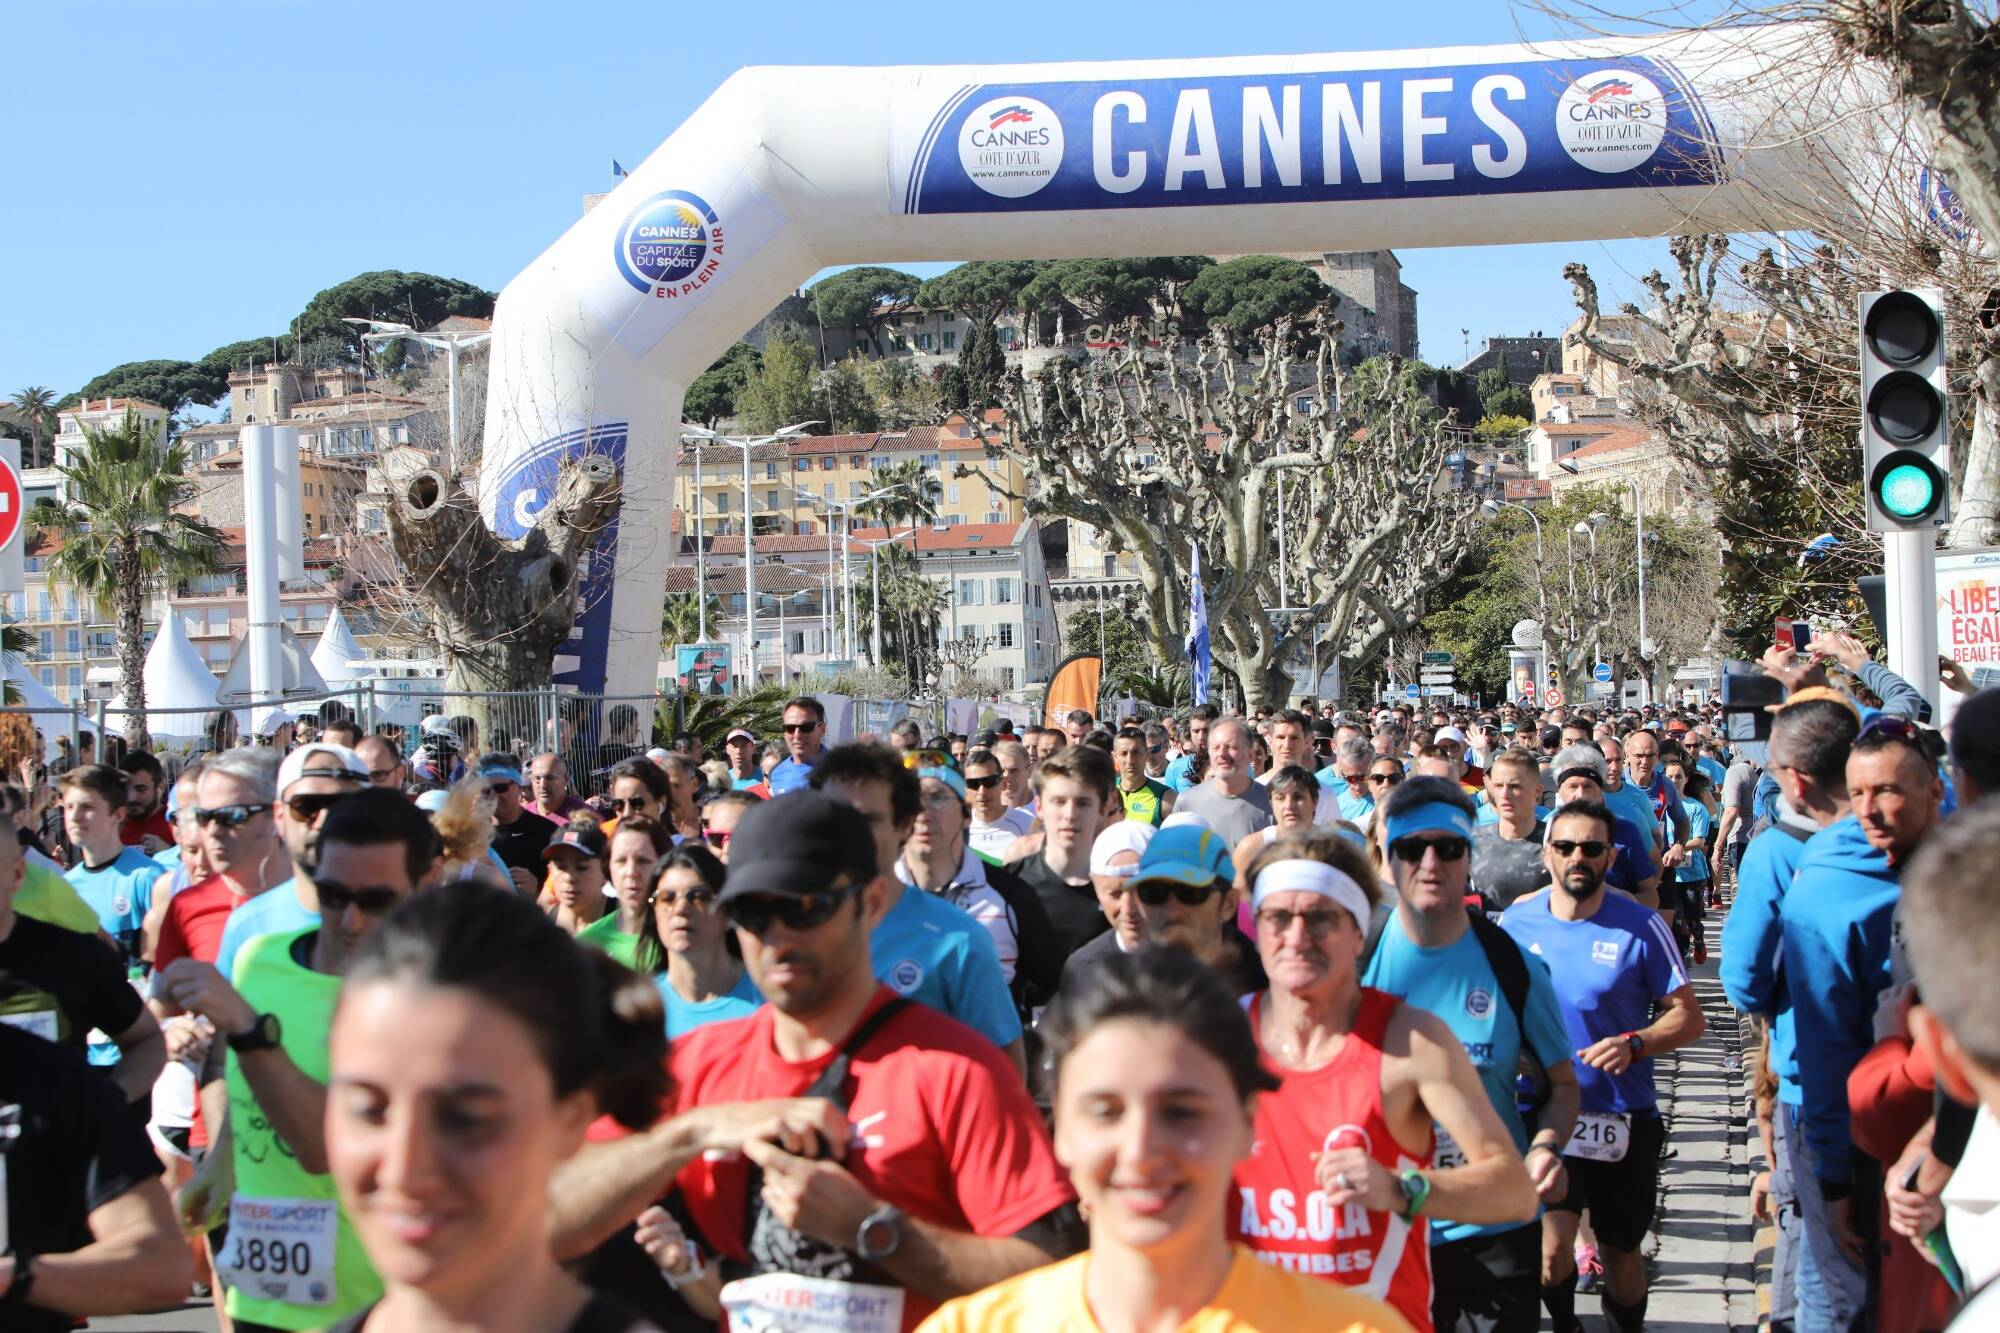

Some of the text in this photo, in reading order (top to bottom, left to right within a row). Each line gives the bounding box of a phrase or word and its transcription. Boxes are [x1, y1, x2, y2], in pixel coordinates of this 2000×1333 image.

[1569, 103, 1651, 122] CANNES
[972, 128, 1049, 147] CANNES
[1093, 75, 1527, 193] CANNES
[1578, 123, 1641, 140] CÔTE D'AZUR
[1570, 142, 1652, 154] www.cannes.com
[980, 149, 1040, 166] CÔTE D'AZUR
[972, 168, 1051, 178] www.cannes.com
[639, 226, 698, 239] CANNES
[637, 245, 697, 258] CAPITALE
[636, 256, 697, 267] DU SPORT
[656, 227, 724, 298] EN PLEIN AIR
[1950, 586, 2000, 614] LIBE
[1952, 616, 2000, 644] ÉGAL
[1953, 647, 1986, 662] BEAU
[1573, 1121, 1616, 1144] 216
